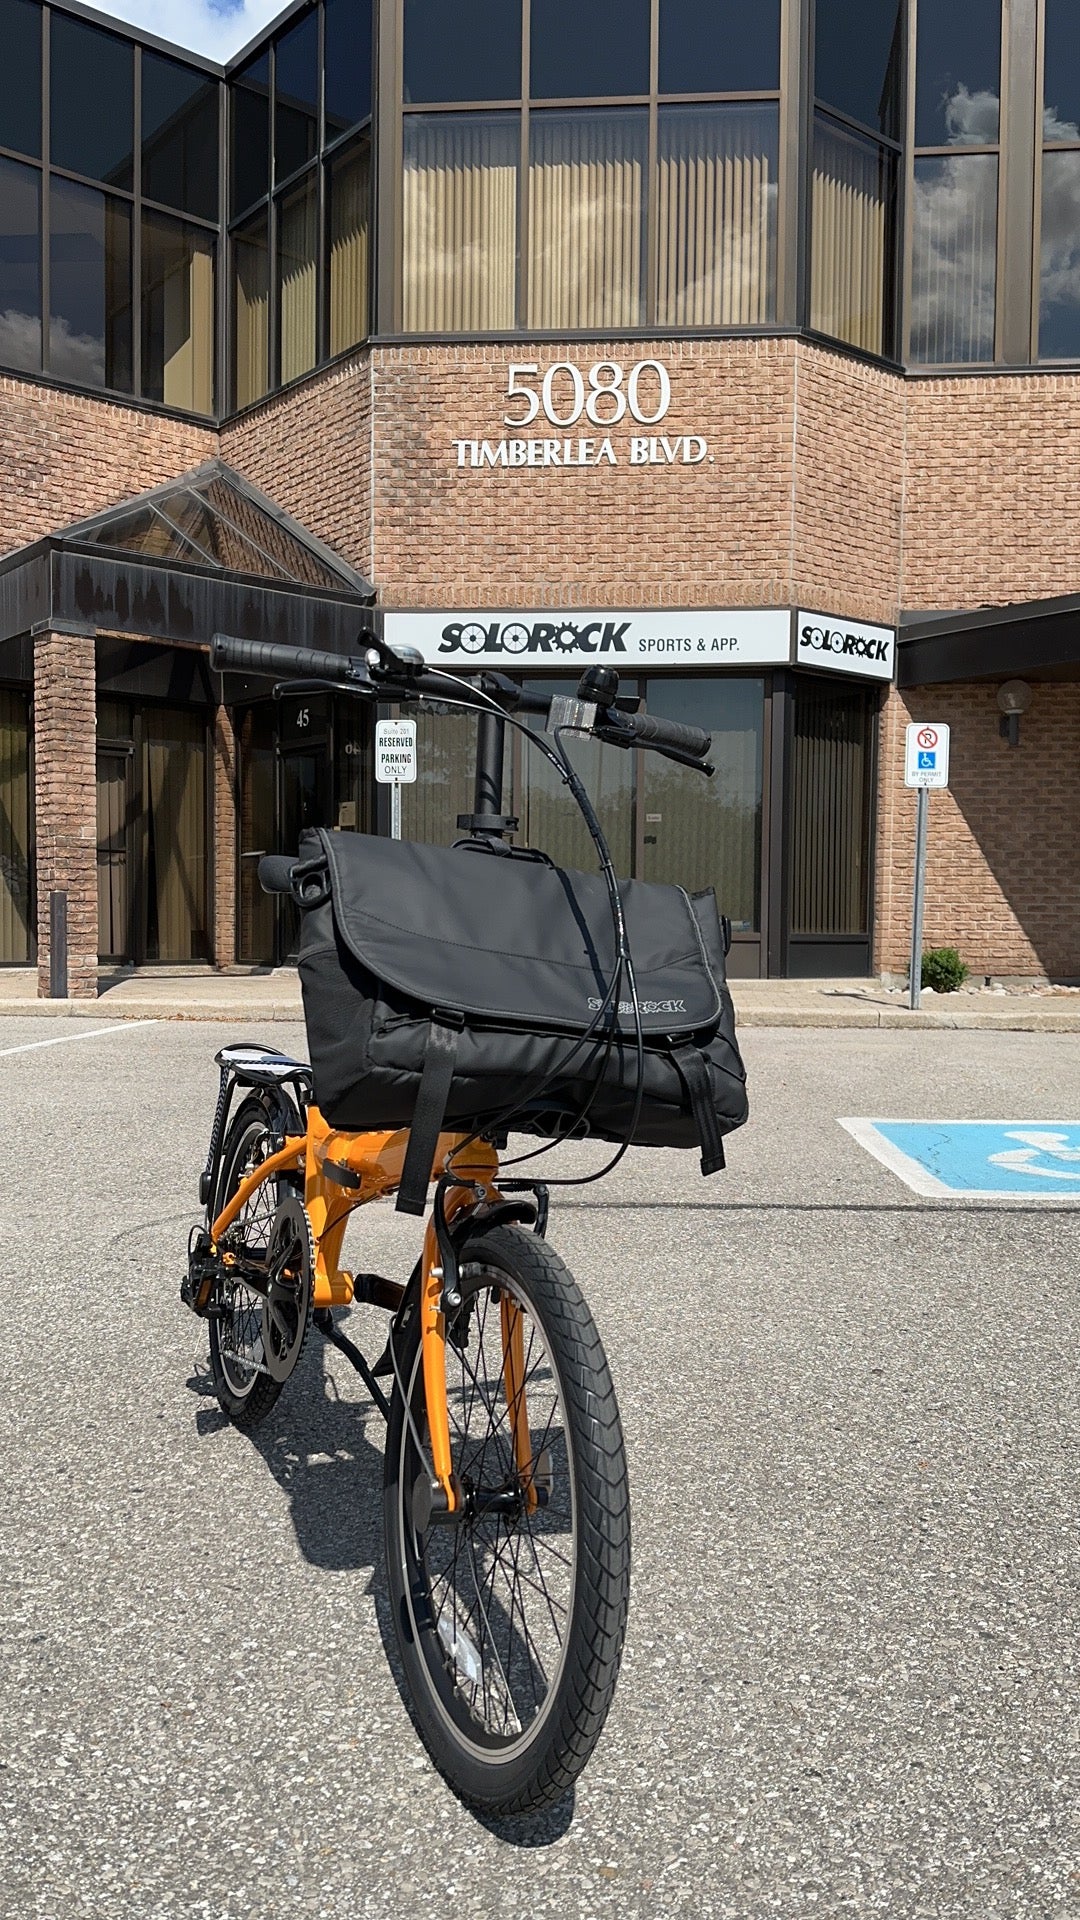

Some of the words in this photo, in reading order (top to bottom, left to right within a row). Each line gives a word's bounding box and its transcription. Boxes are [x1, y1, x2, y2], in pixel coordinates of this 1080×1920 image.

[504, 360, 671, 427] 5080
[452, 438, 617, 467] TIMBERLEA
[629, 435, 715, 465] BLVD.
[438, 621, 632, 654] SOLOROCK
[639, 637, 692, 652] SPORTS
[697, 637, 706, 651] &
[711, 636, 740, 651] APP.
[800, 626, 889, 662] SOLOROCK
[296, 708, 309, 727] 45
[383, 727, 398, 735] Suite
[379, 737, 413, 747] RESERVED
[381, 754, 412, 764] PARKING
[384, 765, 407, 774] ONLY
